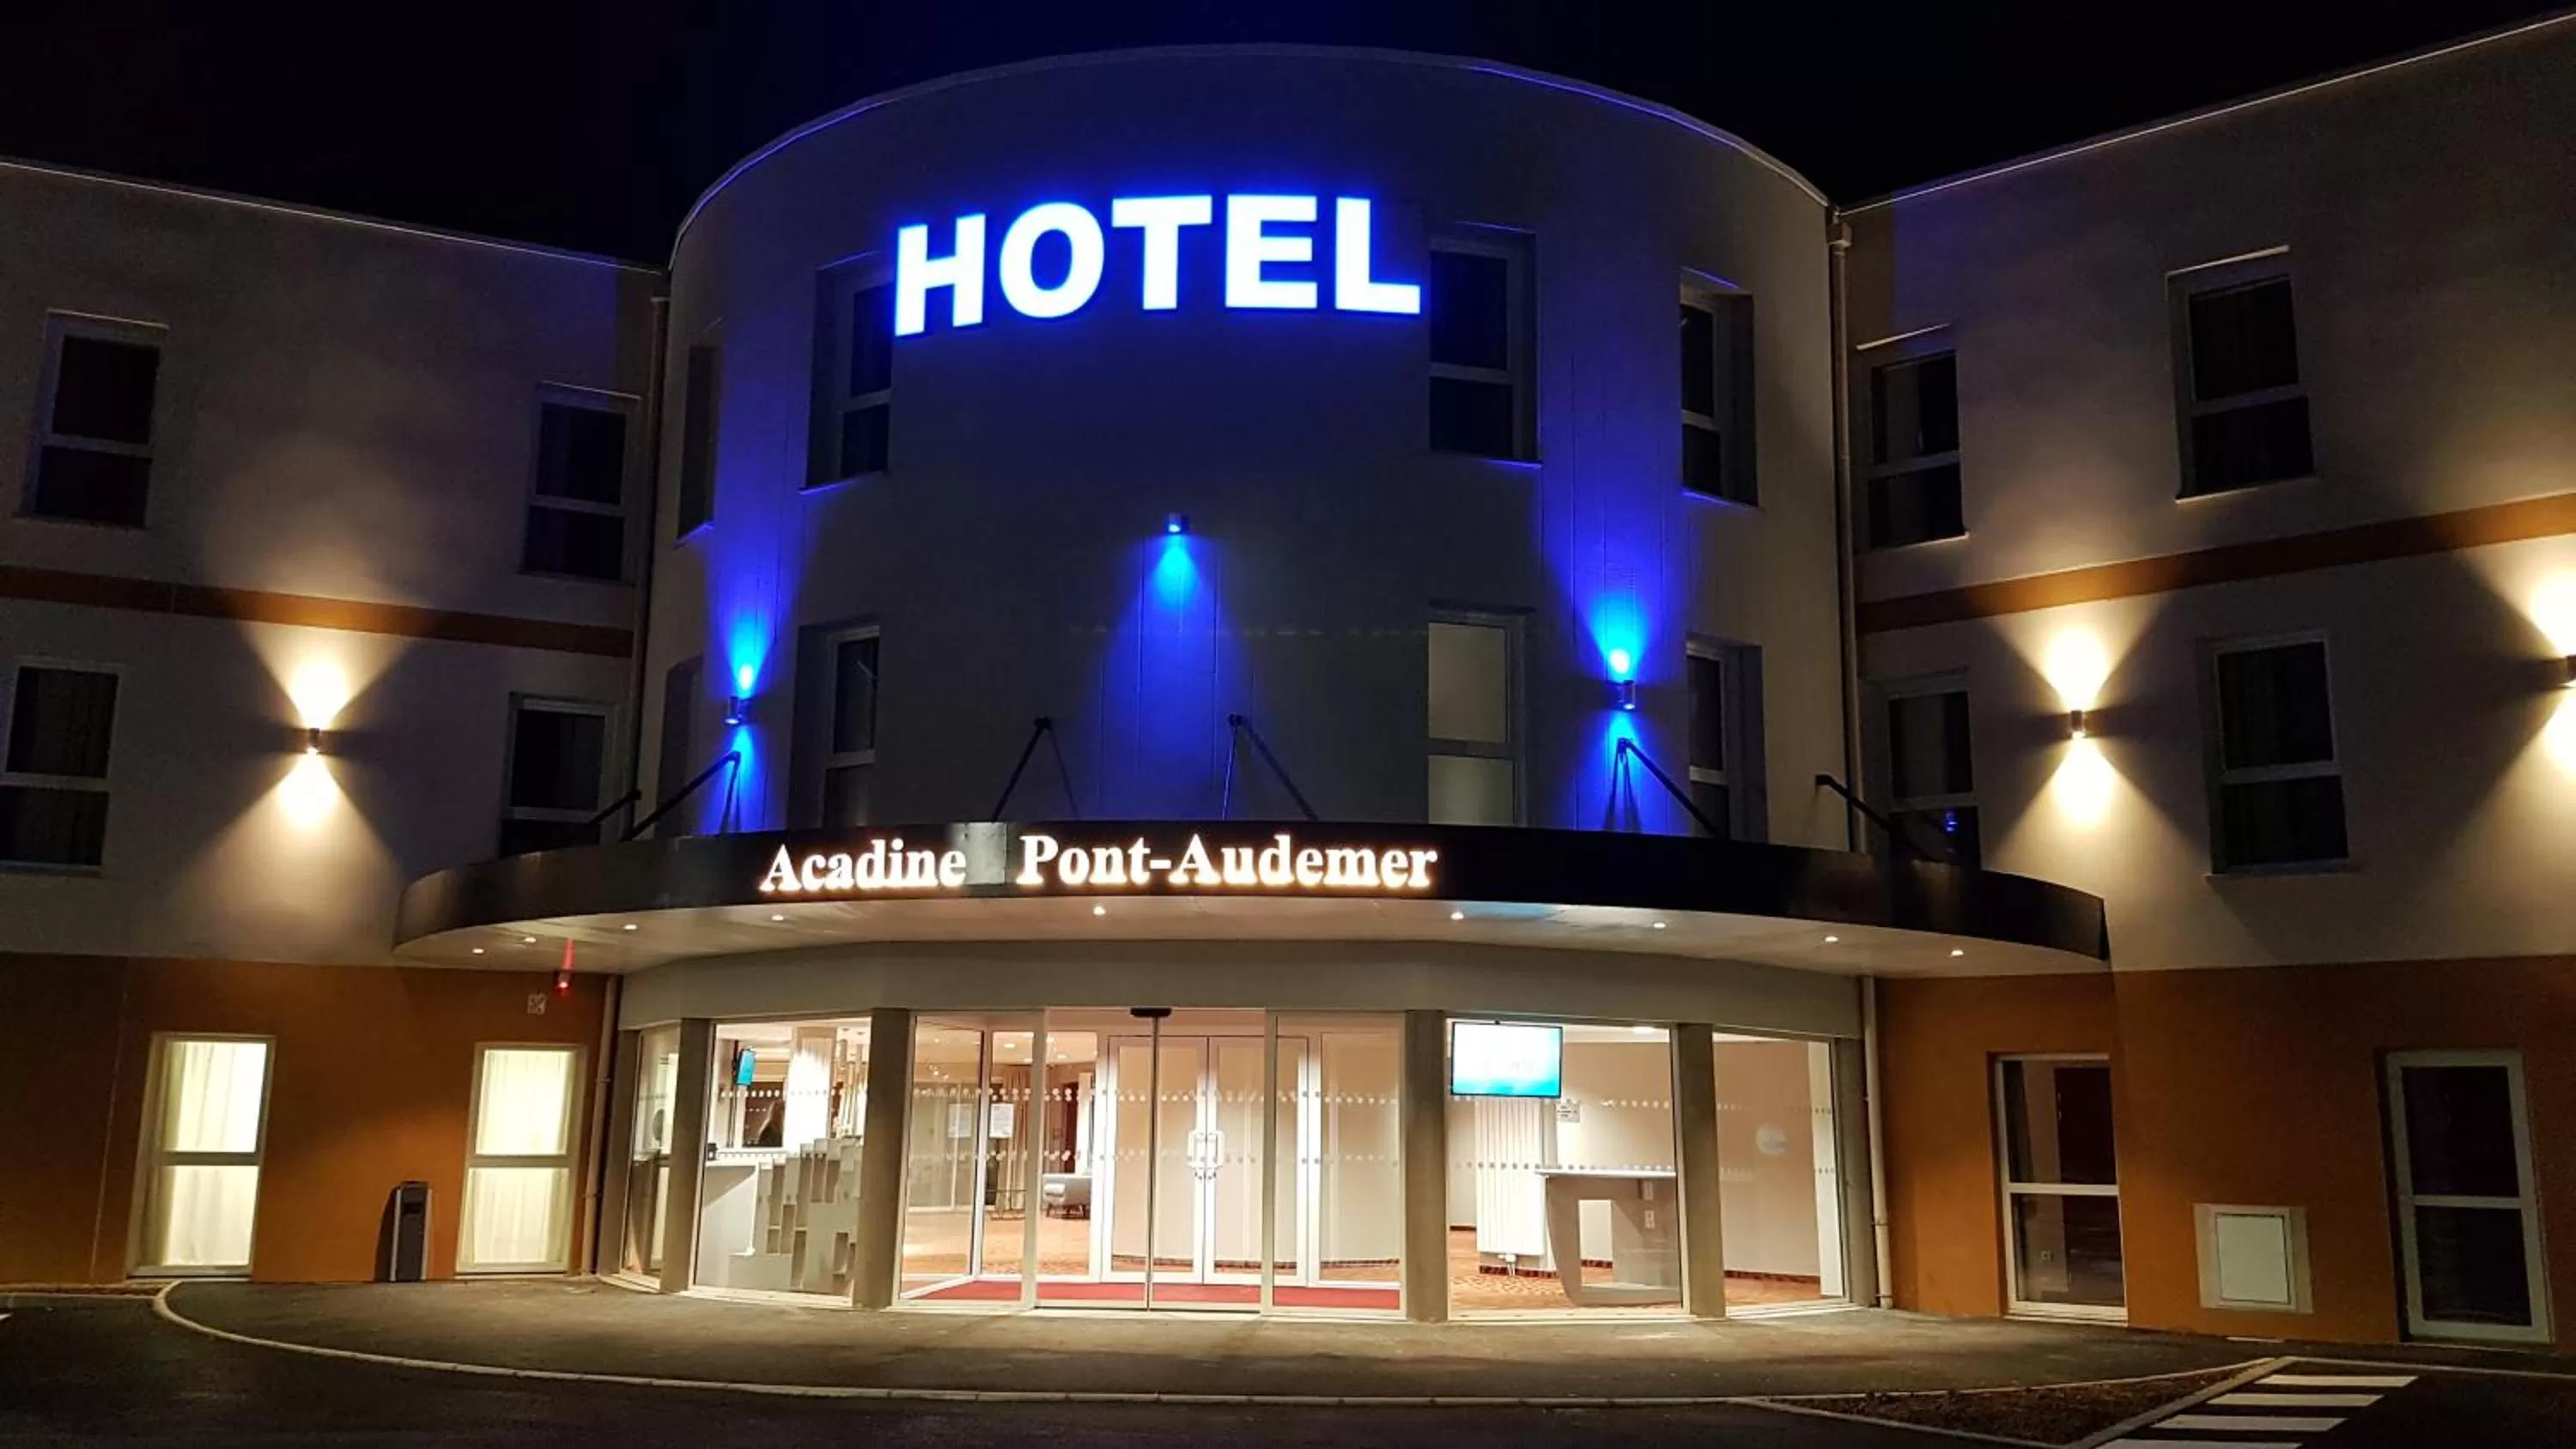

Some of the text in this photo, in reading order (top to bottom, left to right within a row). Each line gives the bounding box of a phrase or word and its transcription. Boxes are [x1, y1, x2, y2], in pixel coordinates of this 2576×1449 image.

[895, 194, 1421, 337] HOTEL
[759, 834, 1438, 892] Acadine Pont-Audemer
